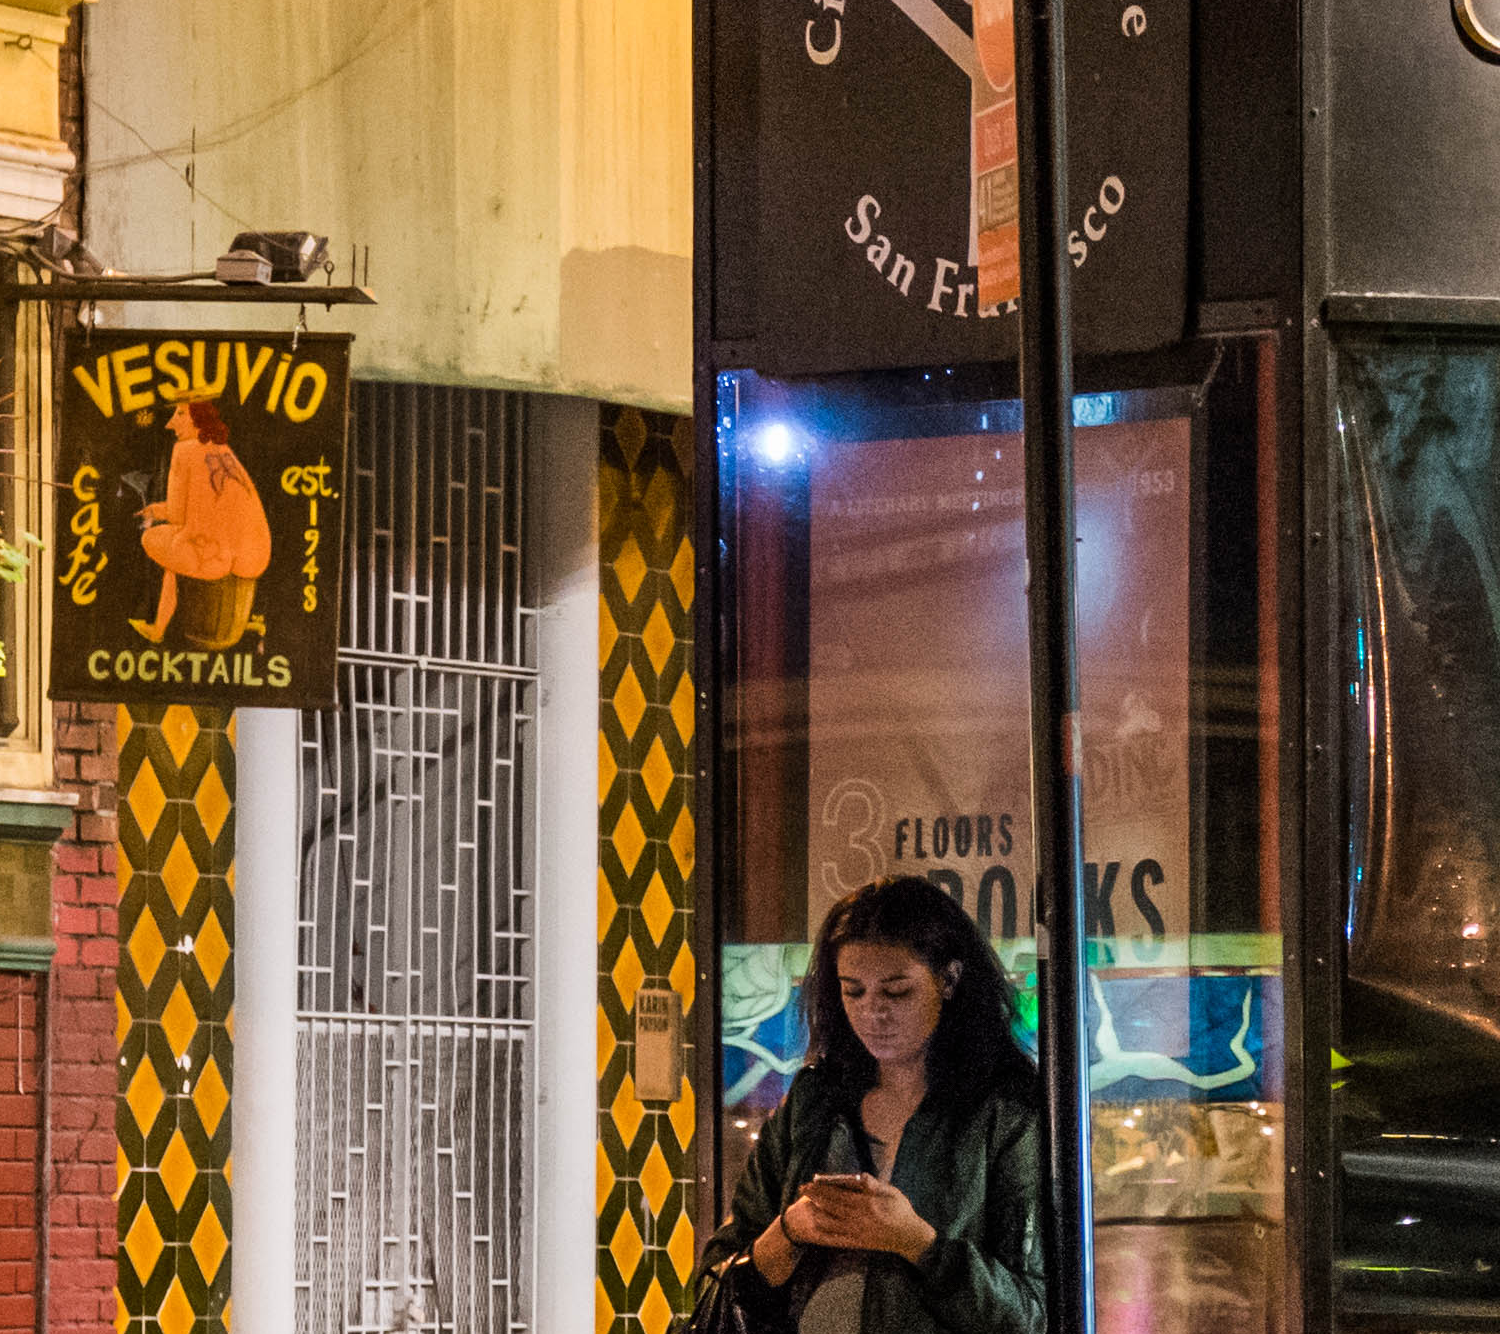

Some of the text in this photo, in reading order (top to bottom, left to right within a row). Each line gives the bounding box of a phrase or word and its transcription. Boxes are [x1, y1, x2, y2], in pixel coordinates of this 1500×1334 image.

[845, 194, 912, 296] San
[927, 175, 1126, 319] Frsco
[73, 340, 328, 423] VESUVIO
[280, 455, 340, 500] est.
[302, 498, 320, 612] 1948
[88, 649, 293, 688] COCKTAILS
[894, 813, 1013, 860] FLOORS
[927, 857, 1166, 963] OKS
